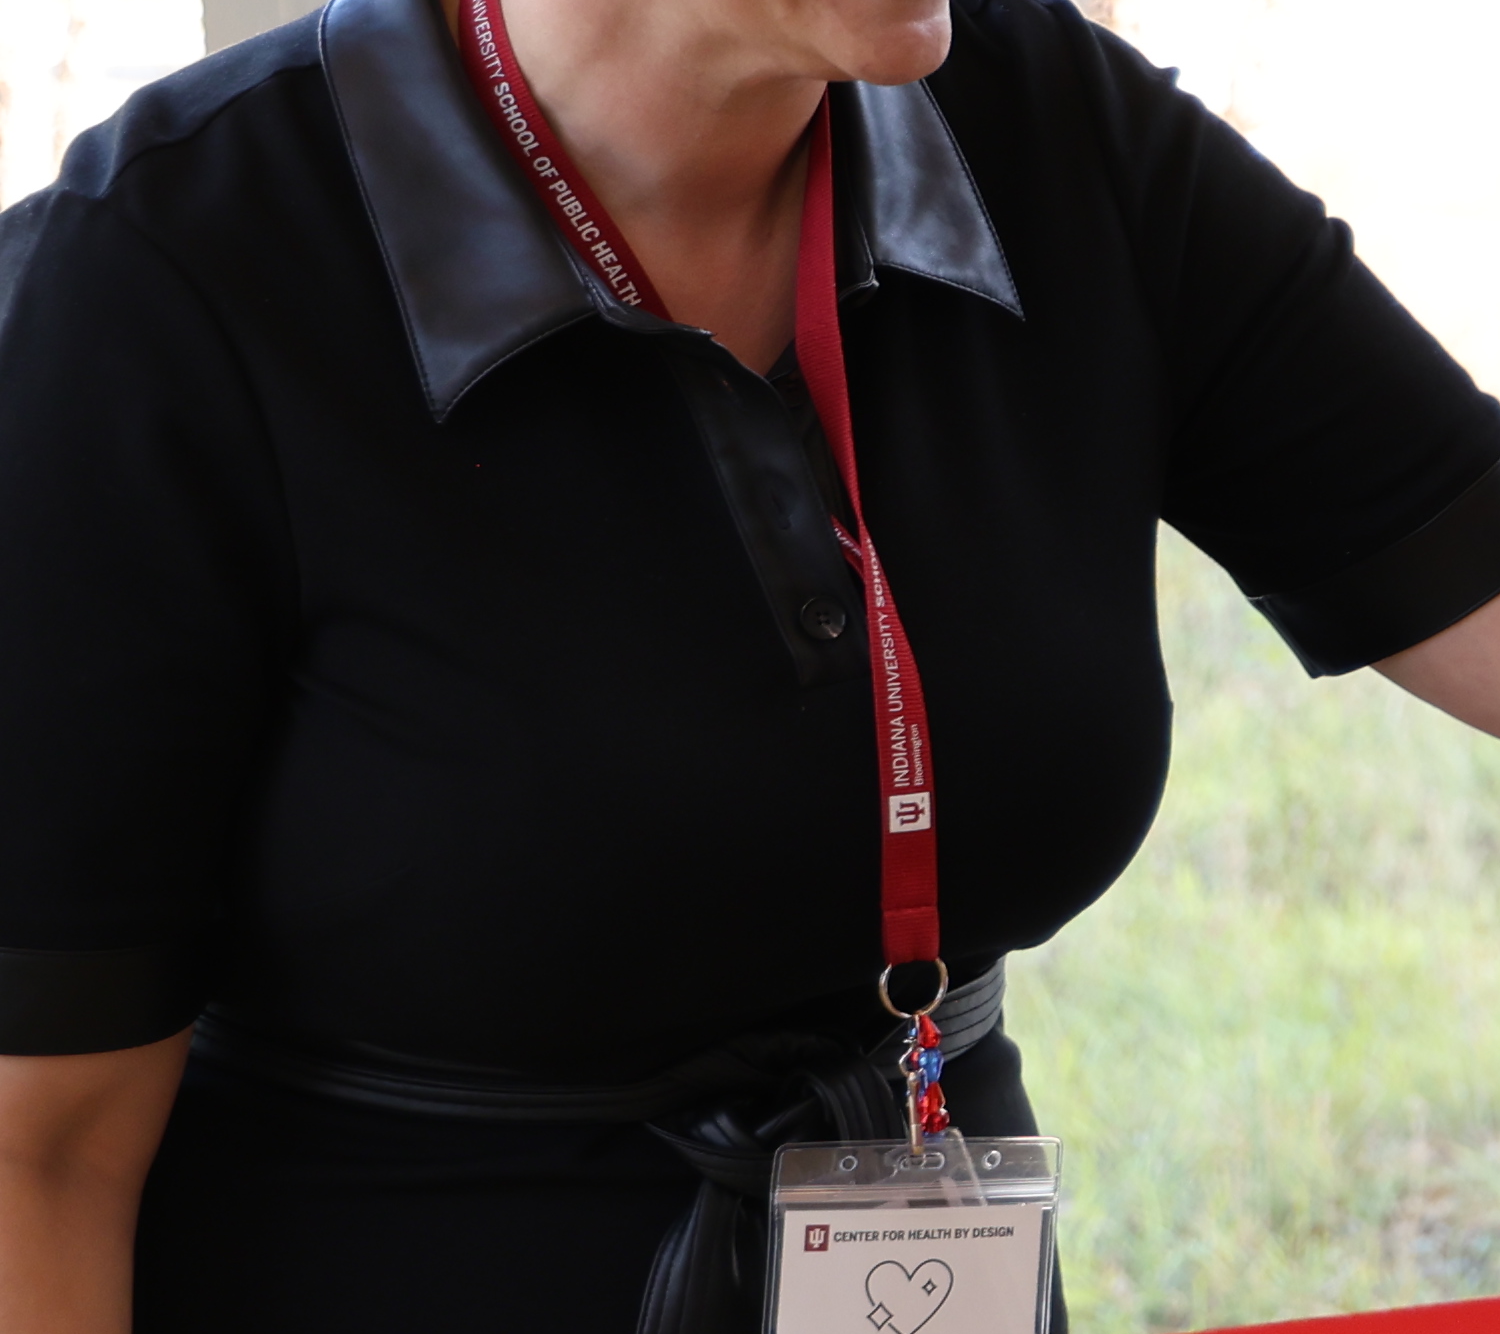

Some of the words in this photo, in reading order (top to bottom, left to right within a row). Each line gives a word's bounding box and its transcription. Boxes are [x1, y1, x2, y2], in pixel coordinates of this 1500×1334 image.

[494, 82, 541, 157] SCHOOL
[533, 155, 558, 178] OF
[549, 180, 600, 243] PUBLIC
[591, 240, 643, 307] HEALTH
[877, 611, 904, 713] UNIVERSITY
[889, 715, 911, 788] INDIANA
[910, 723, 924, 787] Bloomington
[833, 1230, 879, 1243] CENTER
[882, 1229, 905, 1242] FOR
[907, 1228, 951, 1241] HEALTH
[954, 1227, 970, 1239] BY
[972, 1226, 1015, 1238] DESIGN
